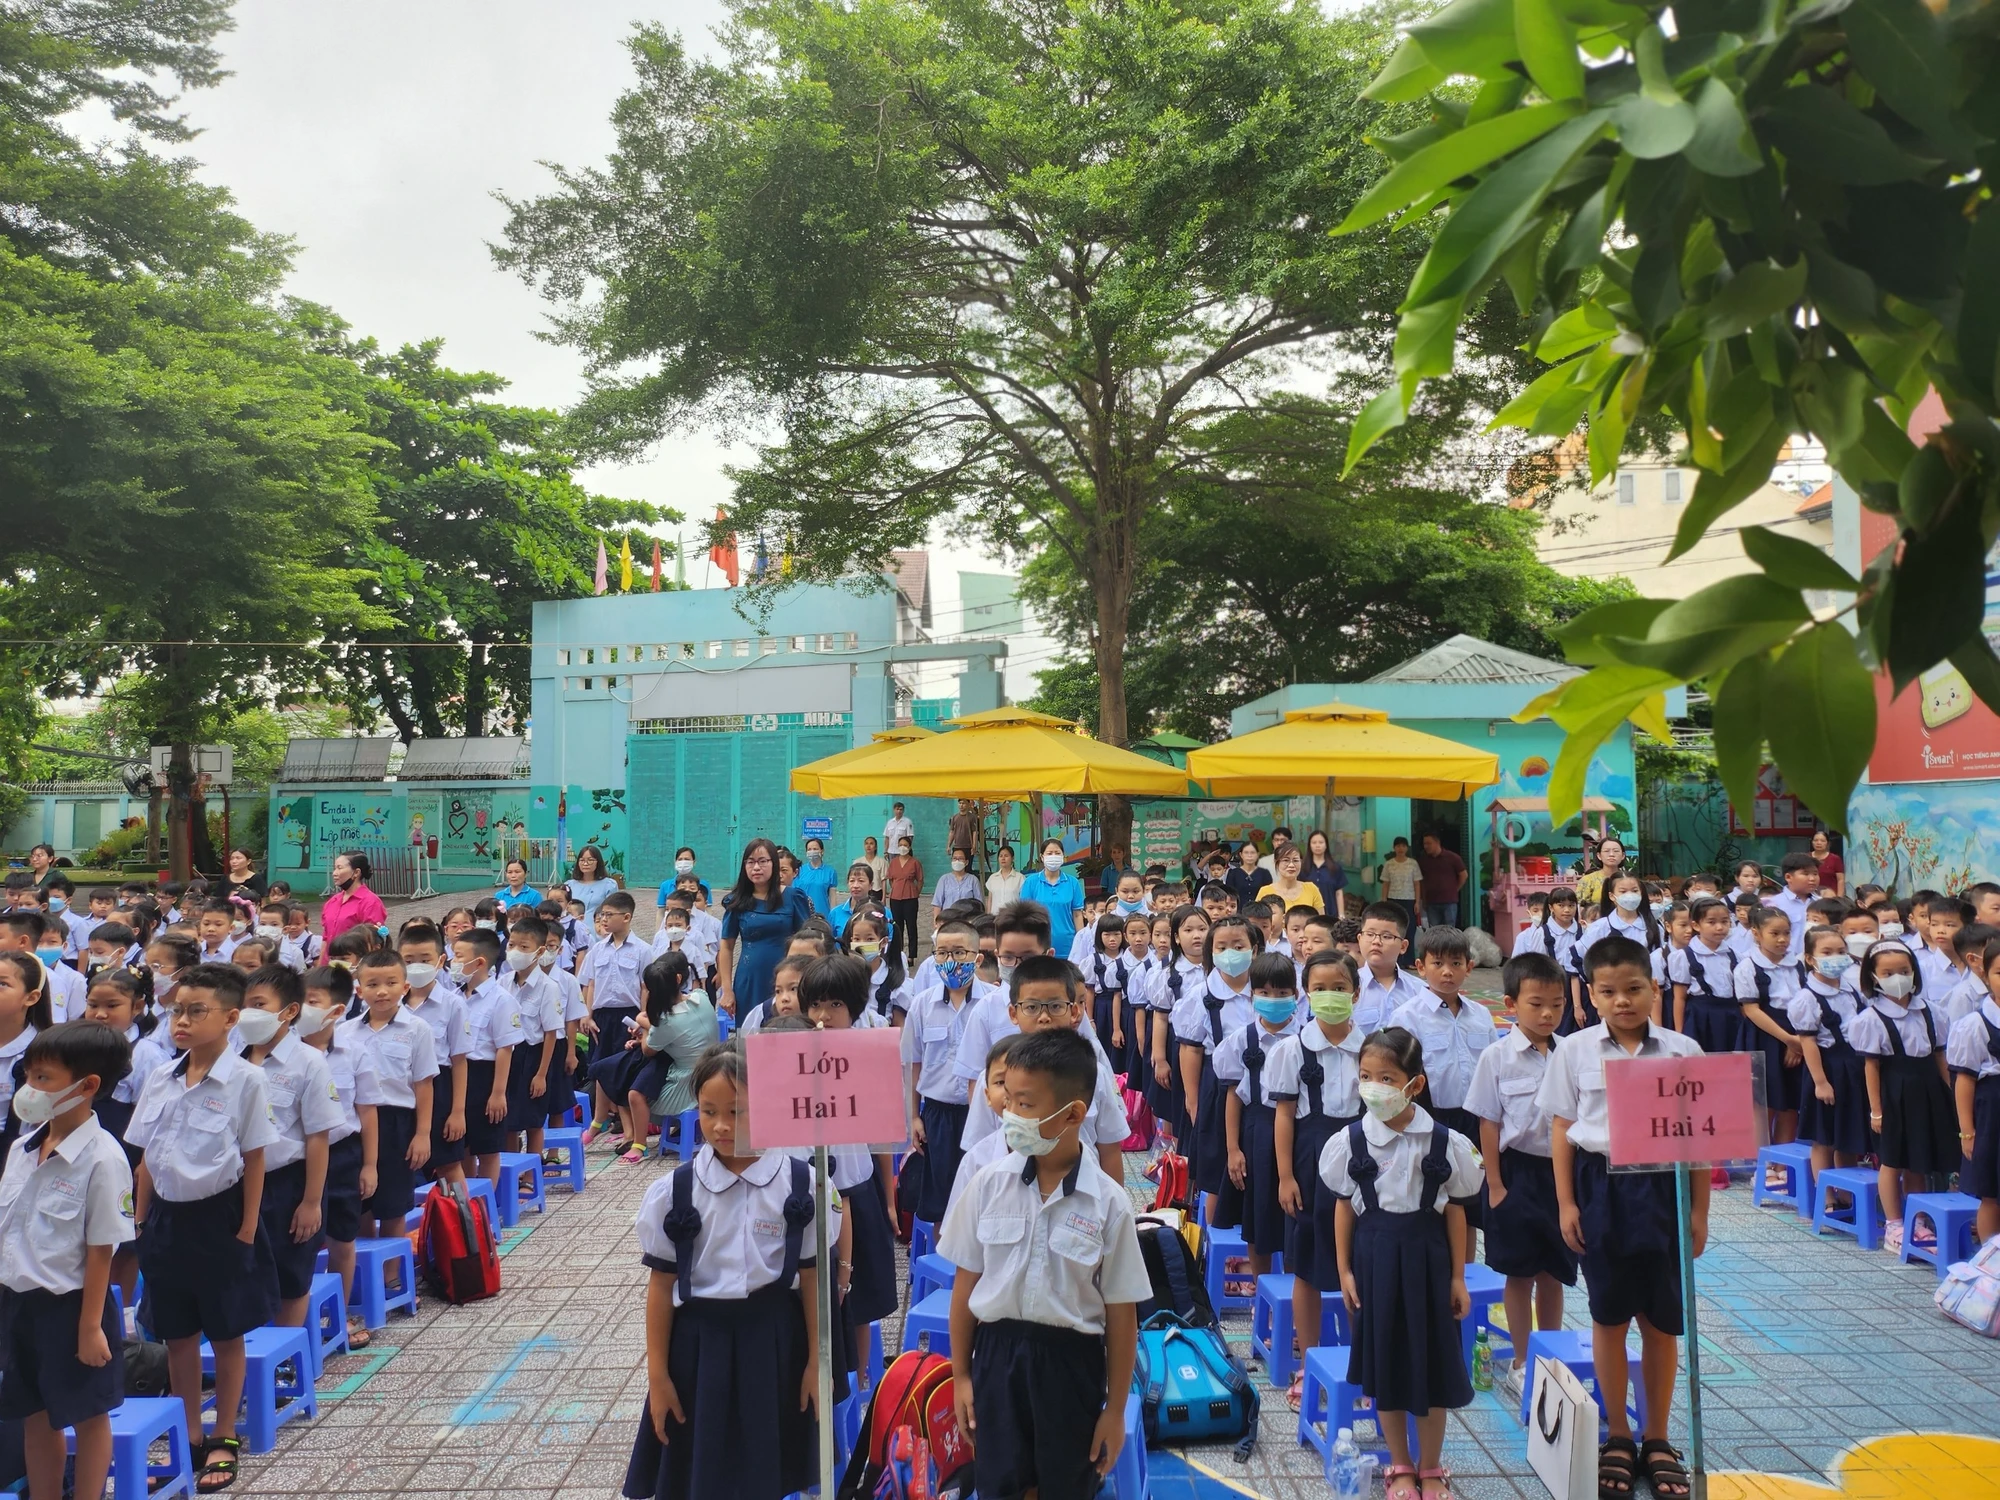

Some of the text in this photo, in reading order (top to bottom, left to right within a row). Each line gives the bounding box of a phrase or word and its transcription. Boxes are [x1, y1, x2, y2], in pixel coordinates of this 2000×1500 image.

[321, 801, 336, 814] Em
[797, 1051, 849, 1080] Lớp
[1656, 1075, 1705, 1101] Lớp
[791, 1094, 858, 1119] Hai 1
[1650, 1115, 1716, 1137] Hai 4
